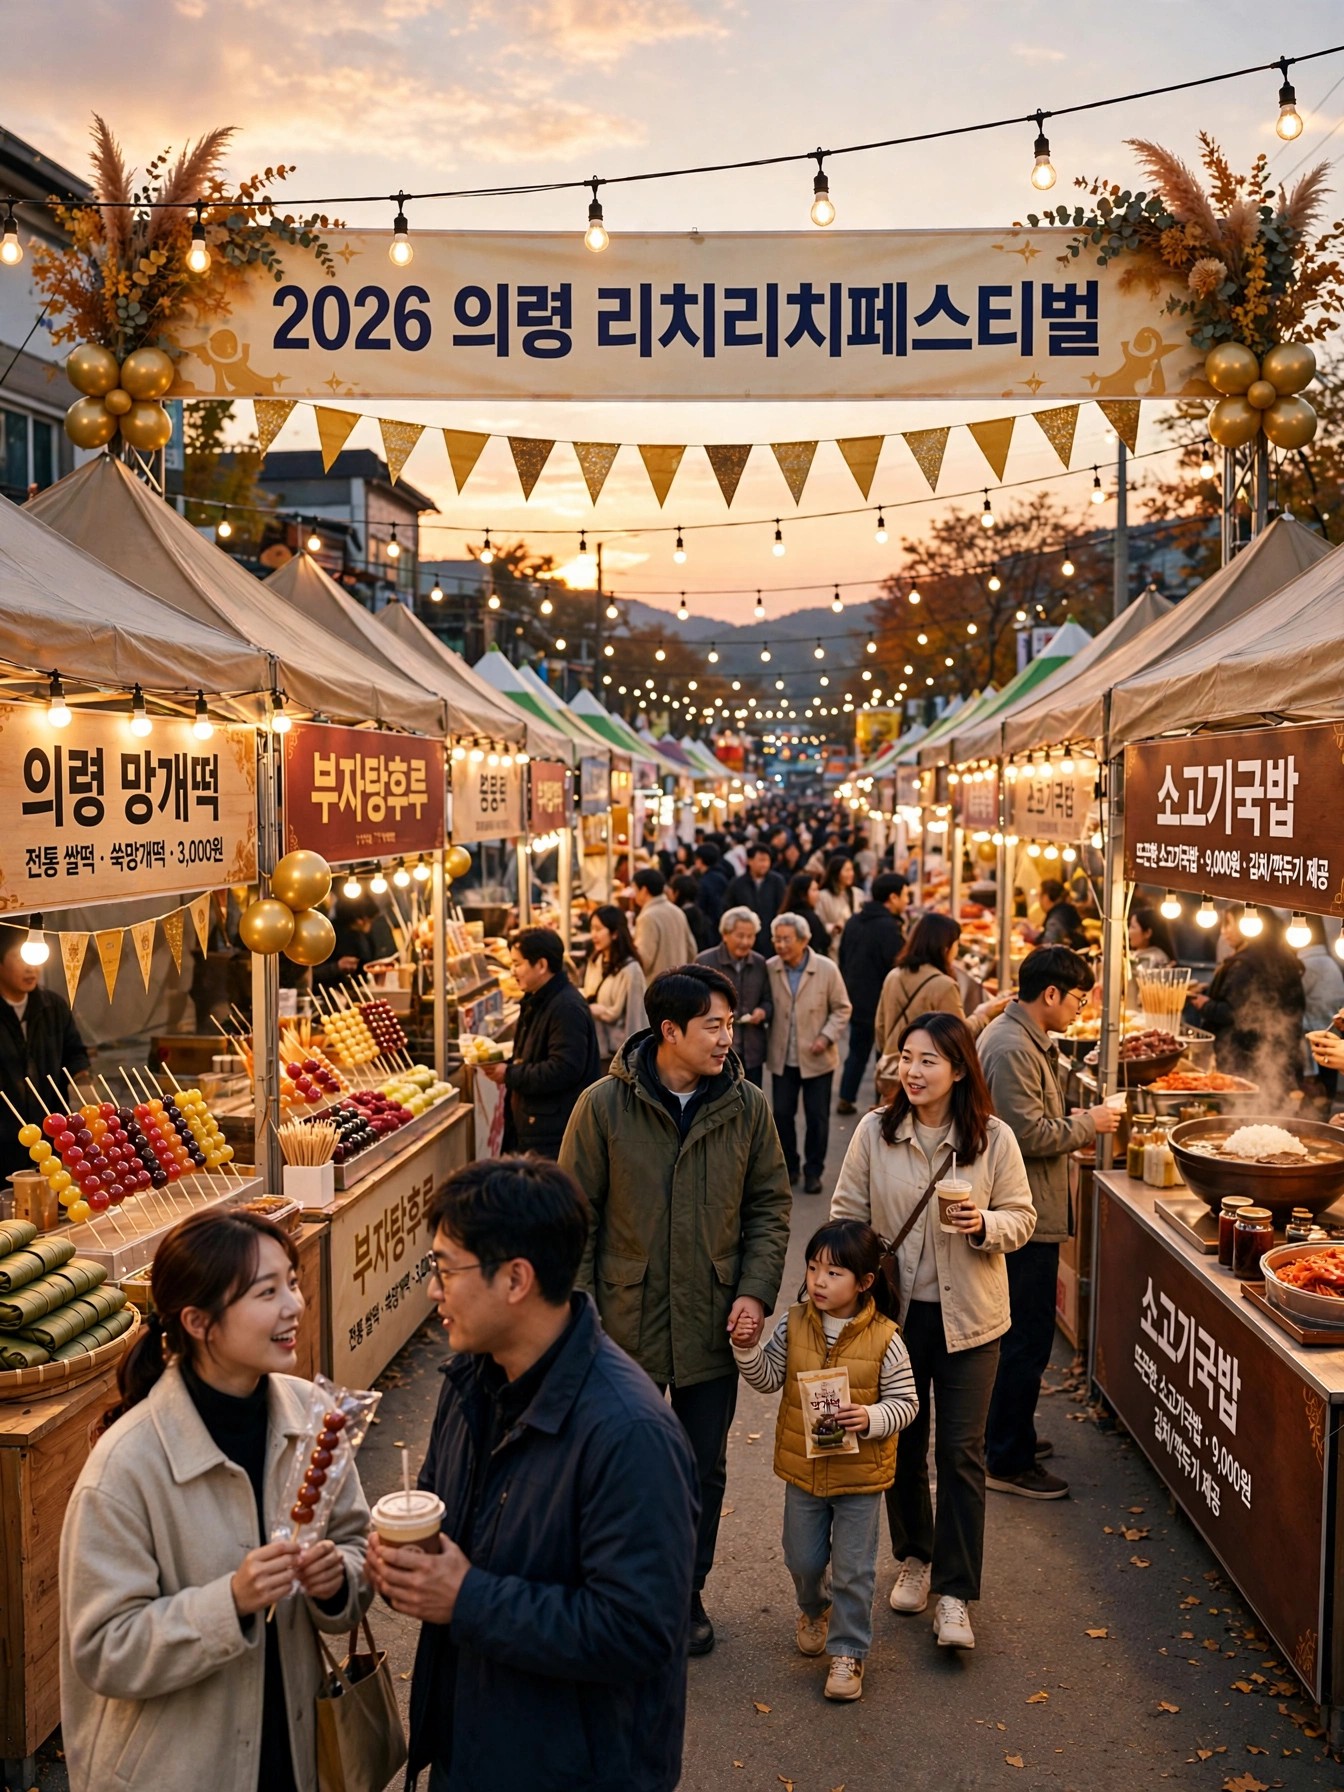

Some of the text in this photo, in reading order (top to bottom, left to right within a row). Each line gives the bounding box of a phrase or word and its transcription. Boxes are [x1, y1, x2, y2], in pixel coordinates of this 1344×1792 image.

[272, 280, 1100, 358] 2026 의령 리치리치페스티벌
[22, 745, 219, 827] 의령 망개떡
[311, 751, 428, 824] 부자탕후루
[1157, 755, 1299, 838] 소고기국밥
[25, 836, 224, 878] 전통 쌀떡 쑥망개떡 3,000원
[1159, 843, 1199, 873] 소고기국밥
[1205, 849, 1240, 877] 9,000원
[1249, 852, 1303, 886] 김치/깍두기
[1306, 857, 1329, 890] 제공
[1140, 1276, 1242, 1436] 소고기국밥
[1154, 1405, 1221, 1517] 김치/깍두기 제공
[1158, 1374, 1202, 1449] 소고기국밥
[1212, 1435, 1251, 1509] 9,000원
